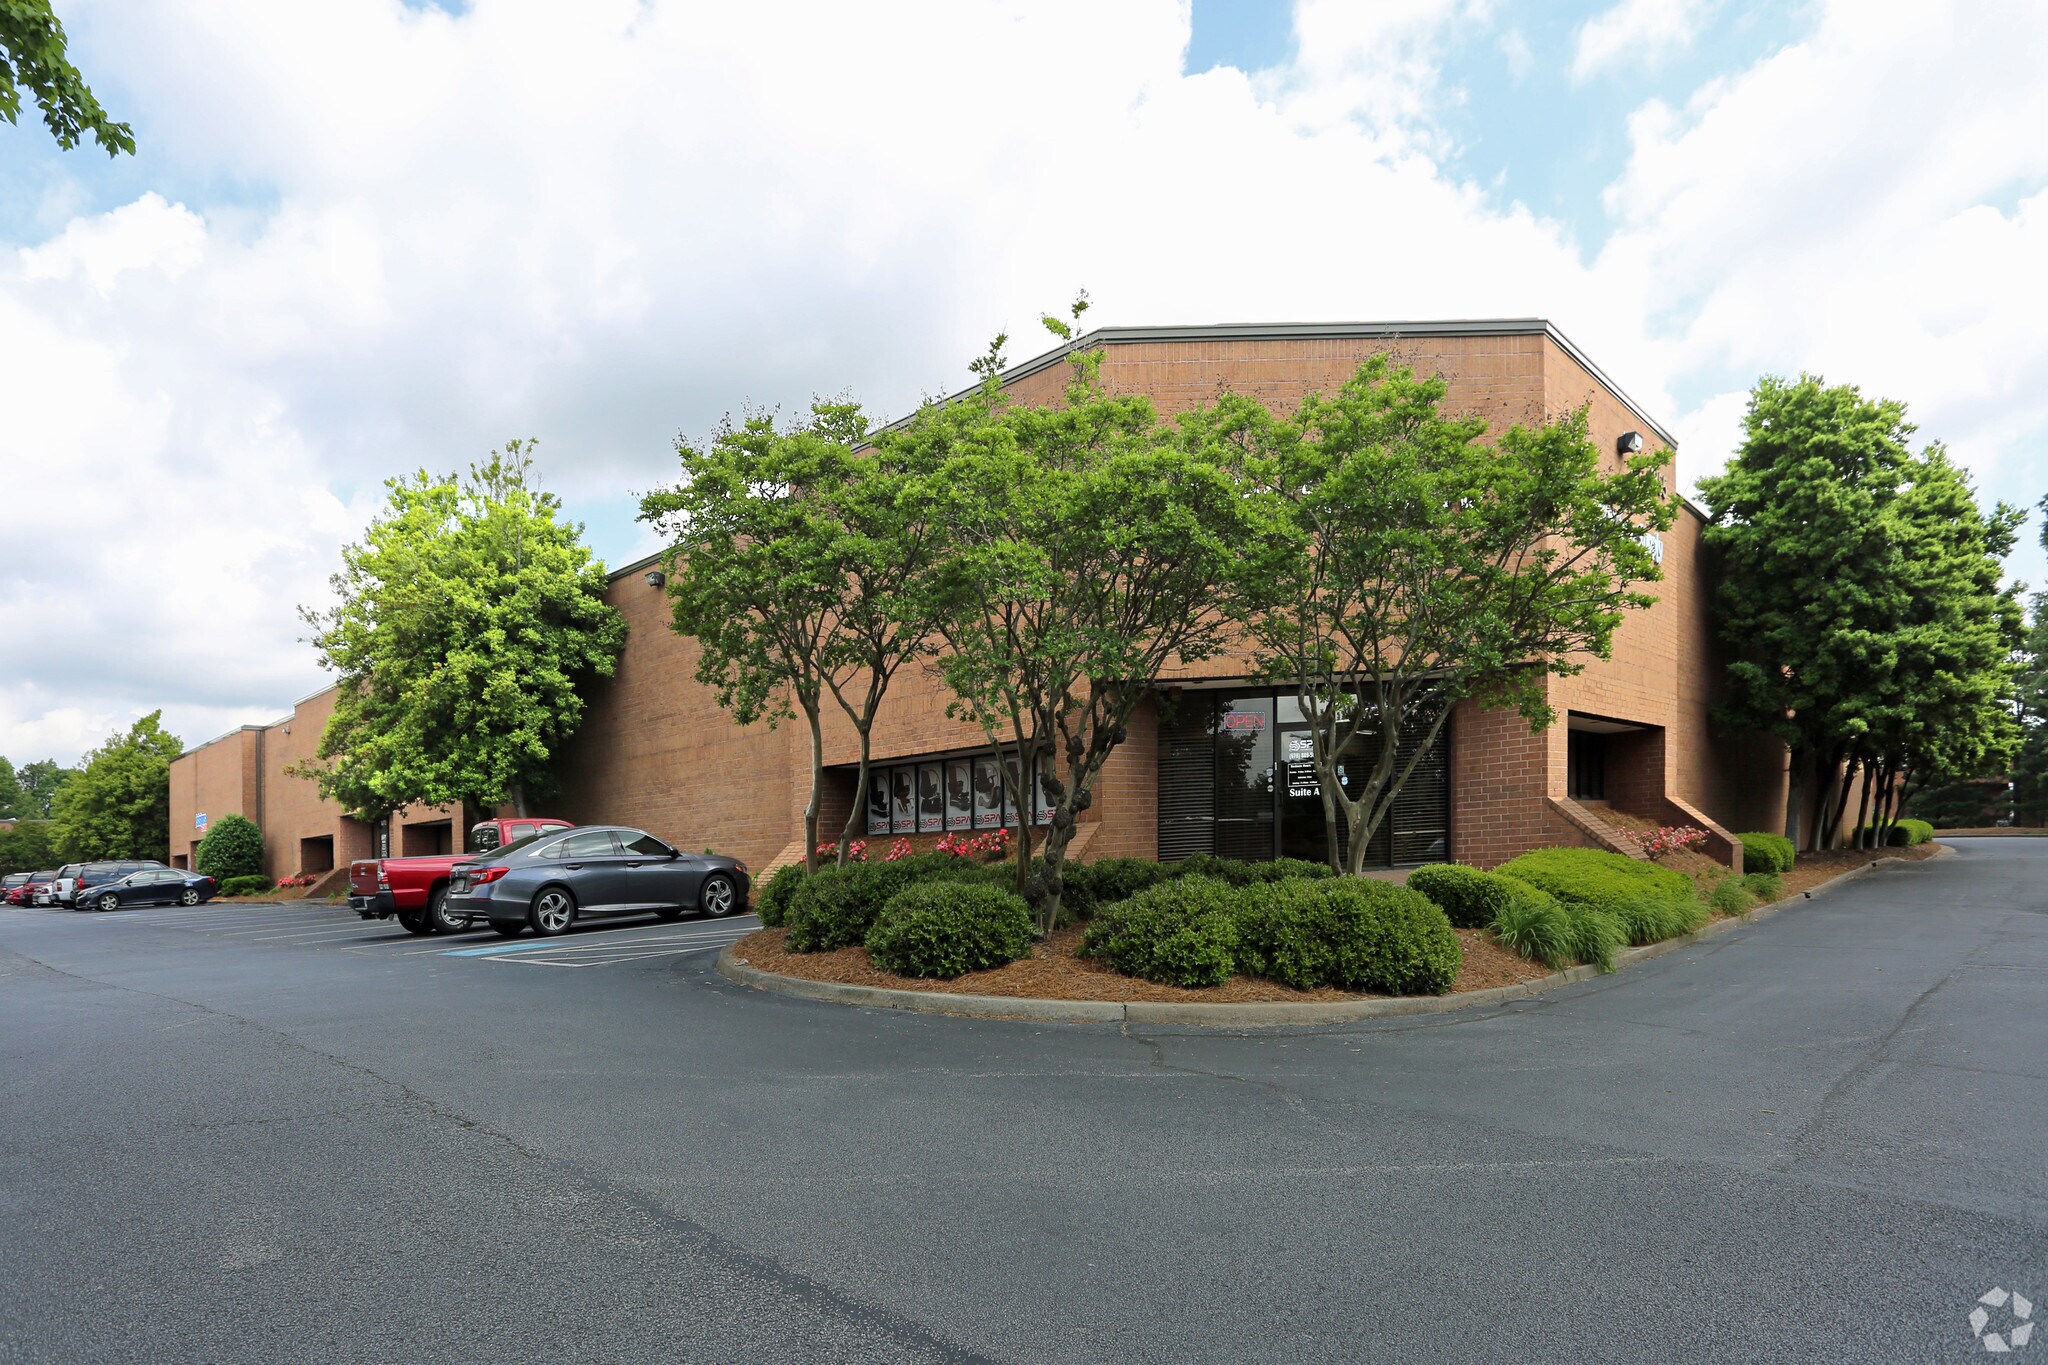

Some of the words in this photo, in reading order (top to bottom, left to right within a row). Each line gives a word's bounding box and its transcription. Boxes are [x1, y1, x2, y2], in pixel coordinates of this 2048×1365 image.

[1225, 714, 1265, 728] OPEN
[1289, 787, 1312, 797] Suite
[1313, 787, 1320, 796] A
